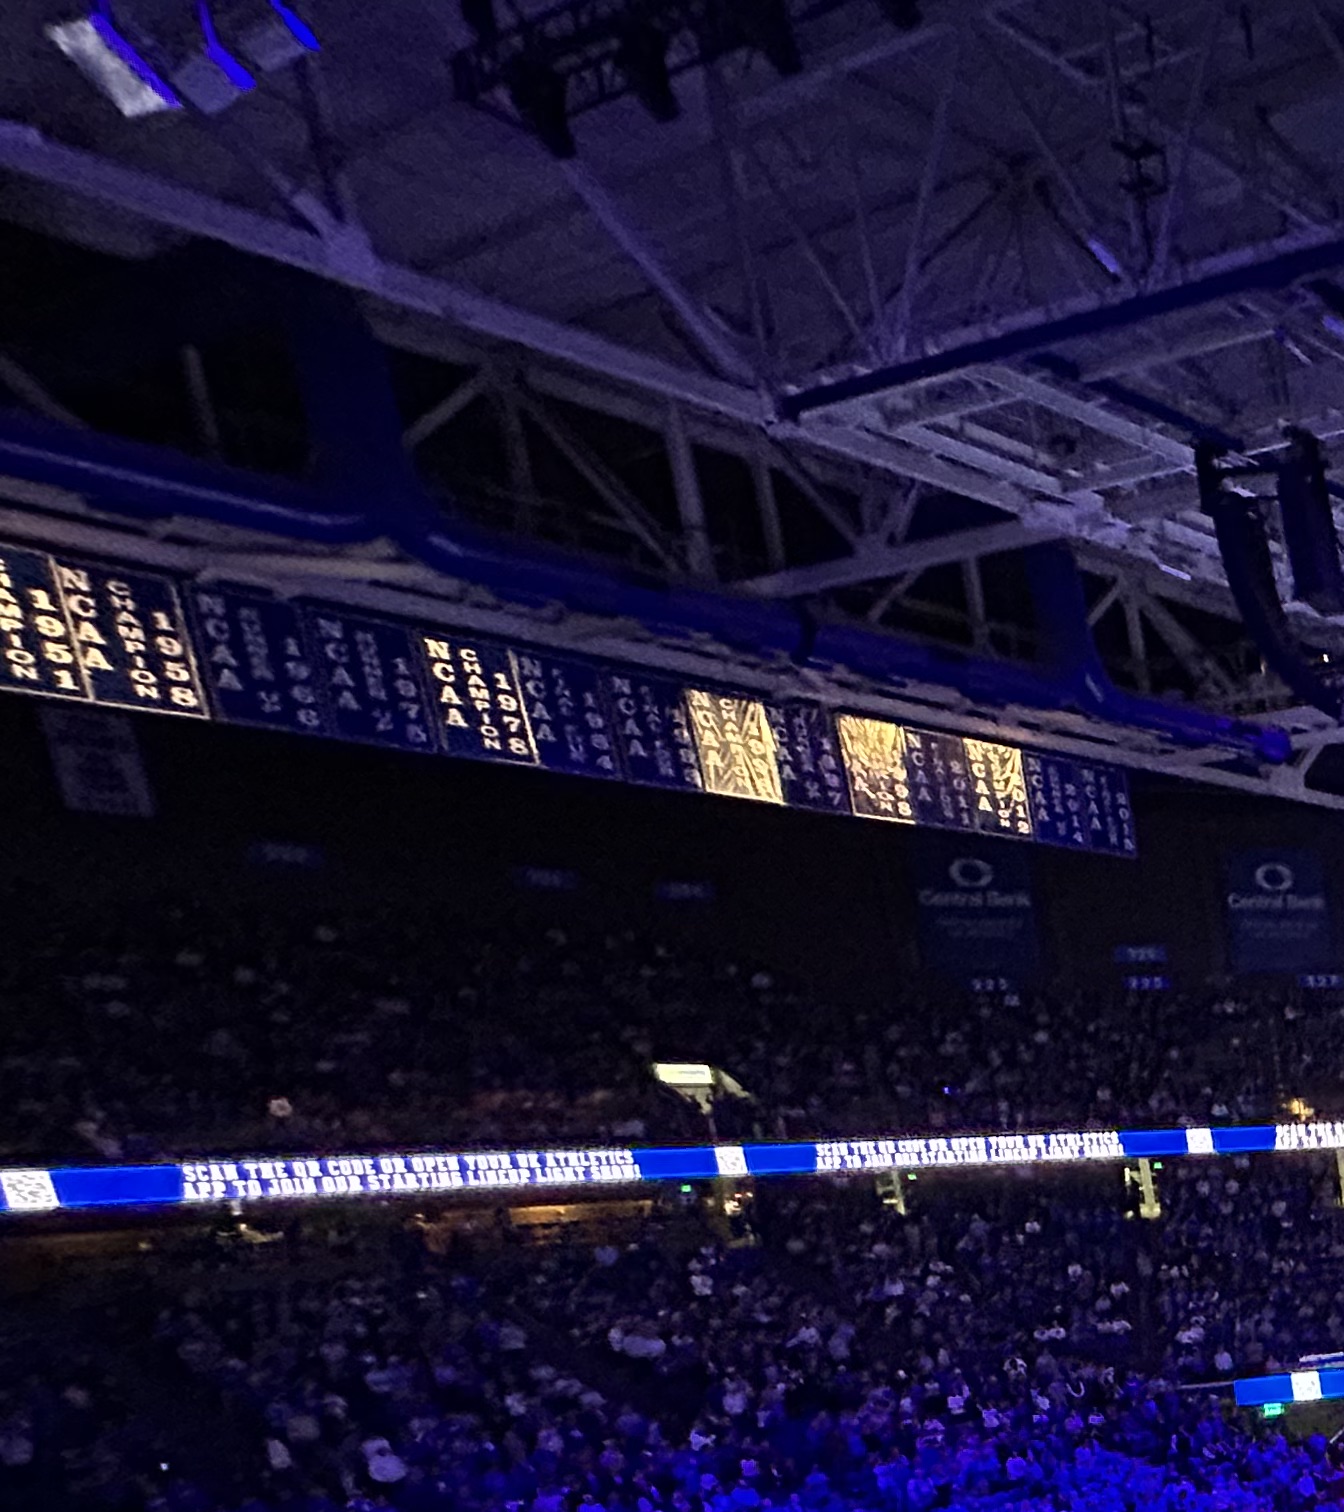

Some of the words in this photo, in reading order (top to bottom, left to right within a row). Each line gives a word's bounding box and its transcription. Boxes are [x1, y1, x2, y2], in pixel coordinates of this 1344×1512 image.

[27, 588, 80, 690] 1951
[58, 565, 114, 671] NCAA
[106, 579, 160, 699] CHAMPION
[151, 611, 198, 708] 1958
[423, 637, 469, 728] NCAA
[458, 648, 502, 750] CHAMPION
[493, 672, 529, 756] 1978
[906, 733, 932, 801] NCAA
[967, 744, 993, 811] NCAA
[180, 1181, 226, 1199] APP
[232, 1179, 261, 1197] TO
[268, 1177, 315, 1195] JOIN
[322, 1175, 363, 1193] OUR
[368, 1171, 462, 1191] STARTING
[467, 1169, 531, 1186] LINEUP
[534, 1166, 587, 1183] LIGHT
[587, 1164, 642, 1181] SHOW!
[181, 1163, 237, 1181] SCAN
[244, 1161, 285, 1179] THE
[293, 1160, 323, 1177] QR
[328, 1158, 374, 1175] CODE
[379, 1157, 406, 1173] OR
[411, 1155, 458, 1172] OPEN
[463, 1153, 511, 1170] YOUR
[515, 1152, 542, 1168] UK
[543, 1149, 634, 1167] ATHLETICS
